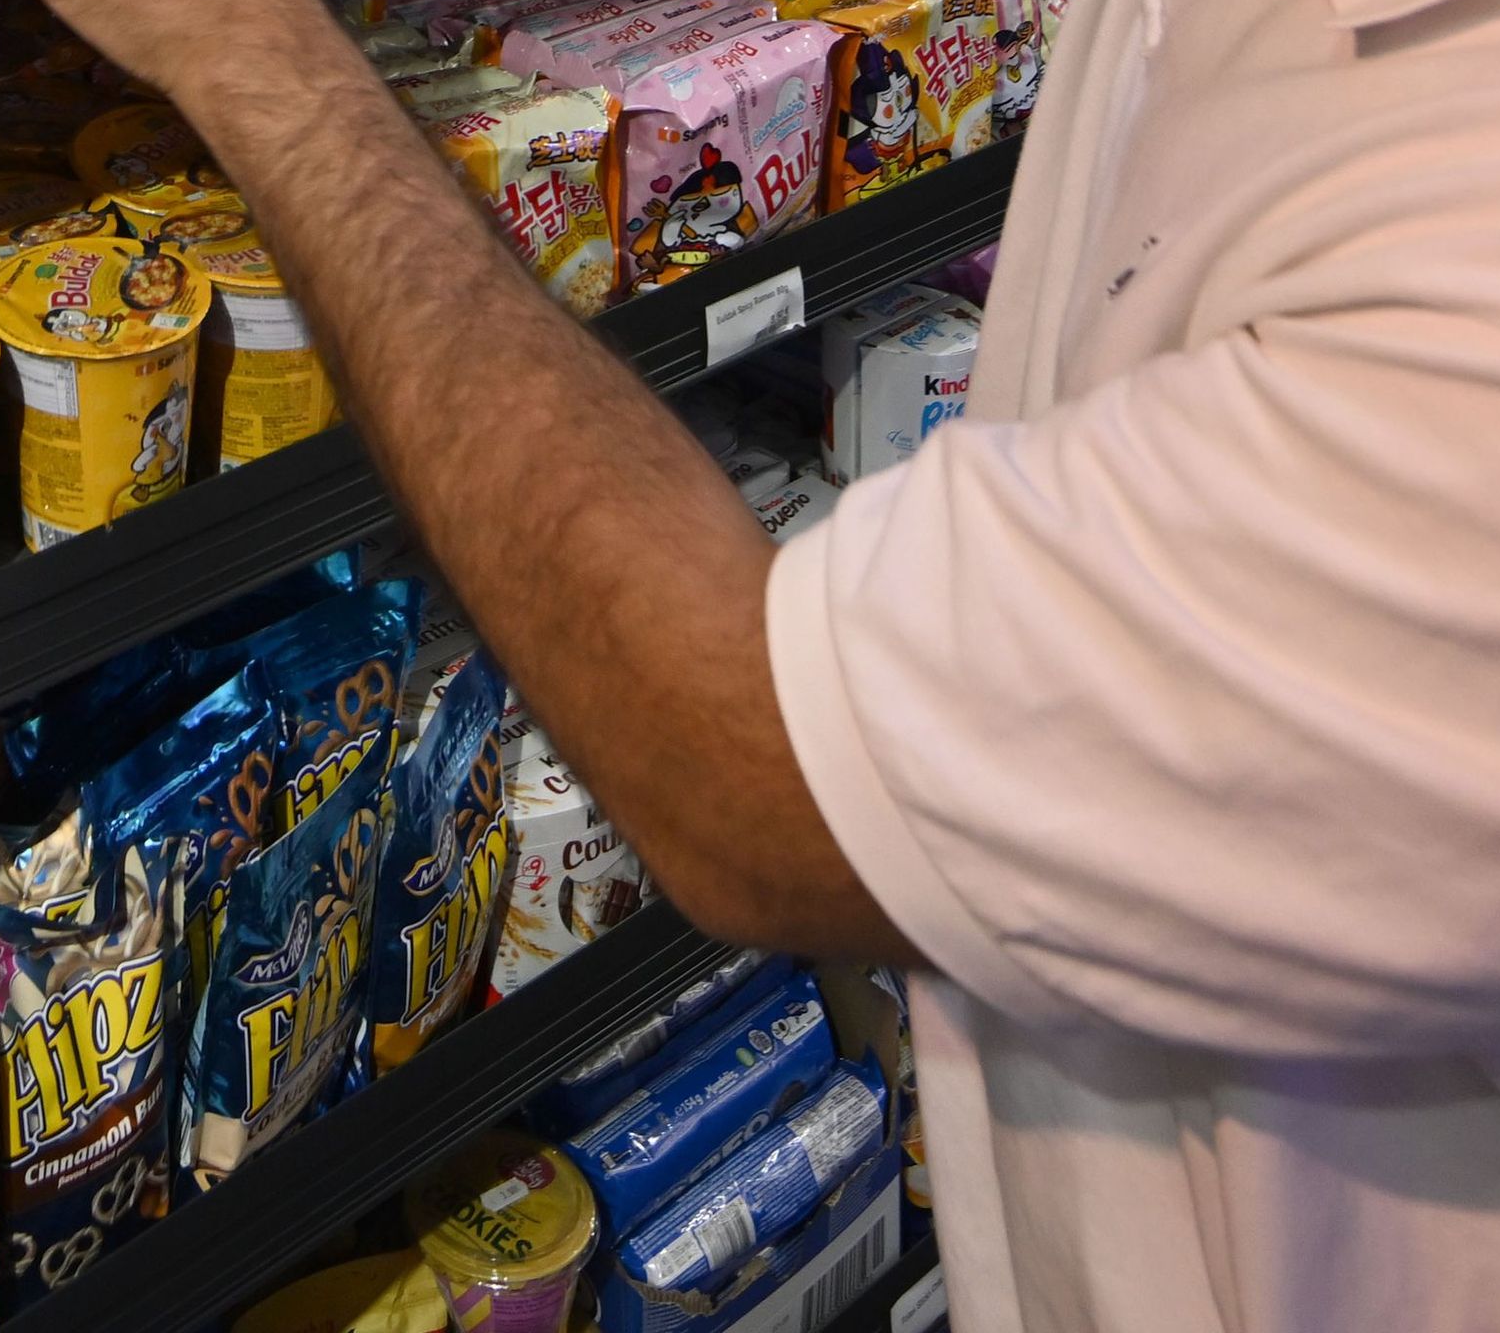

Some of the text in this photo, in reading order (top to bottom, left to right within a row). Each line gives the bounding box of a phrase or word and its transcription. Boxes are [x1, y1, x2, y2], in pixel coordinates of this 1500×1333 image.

[9, 957, 164, 1159] Flipz
[25, 1083, 164, 1187] Cinnamon Bun
